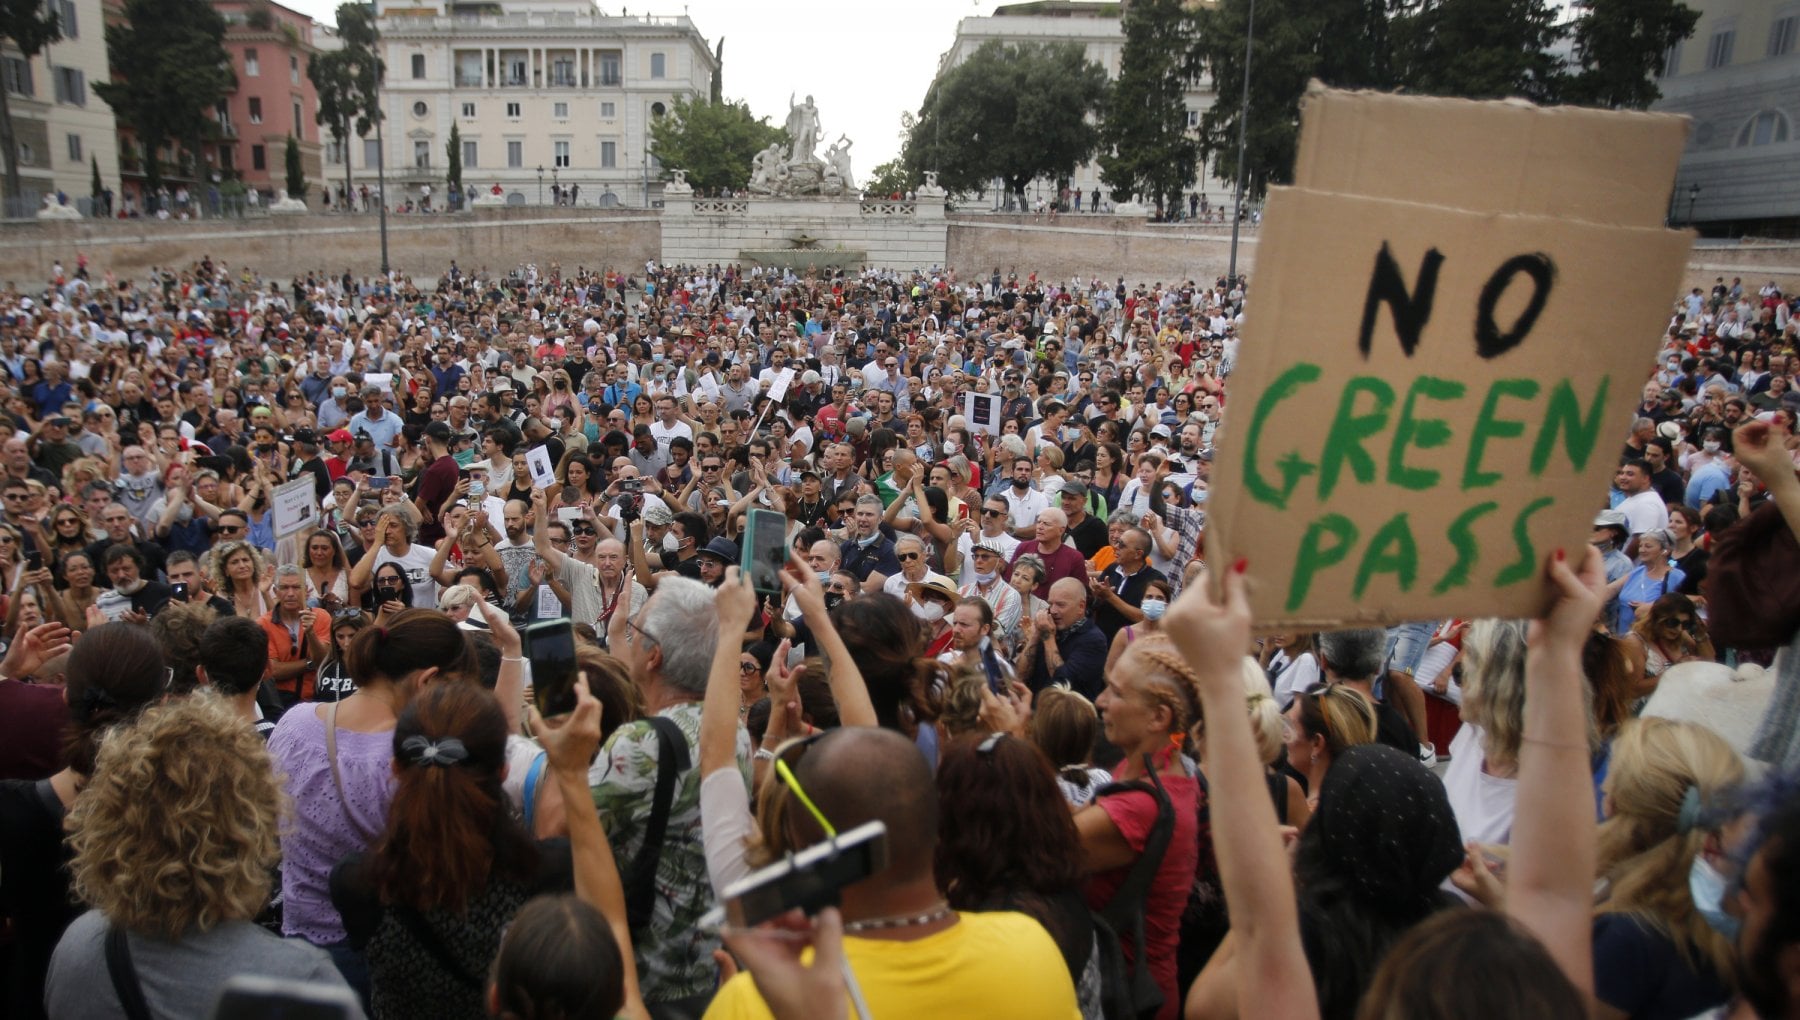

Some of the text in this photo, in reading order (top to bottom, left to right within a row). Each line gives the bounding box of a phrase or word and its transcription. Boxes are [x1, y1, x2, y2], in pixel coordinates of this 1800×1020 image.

[1358, 240, 1558, 360] NO
[1242, 363, 1610, 511] GREEN
[1286, 496, 1556, 612] PASS
[321, 677, 358, 692] PYR
